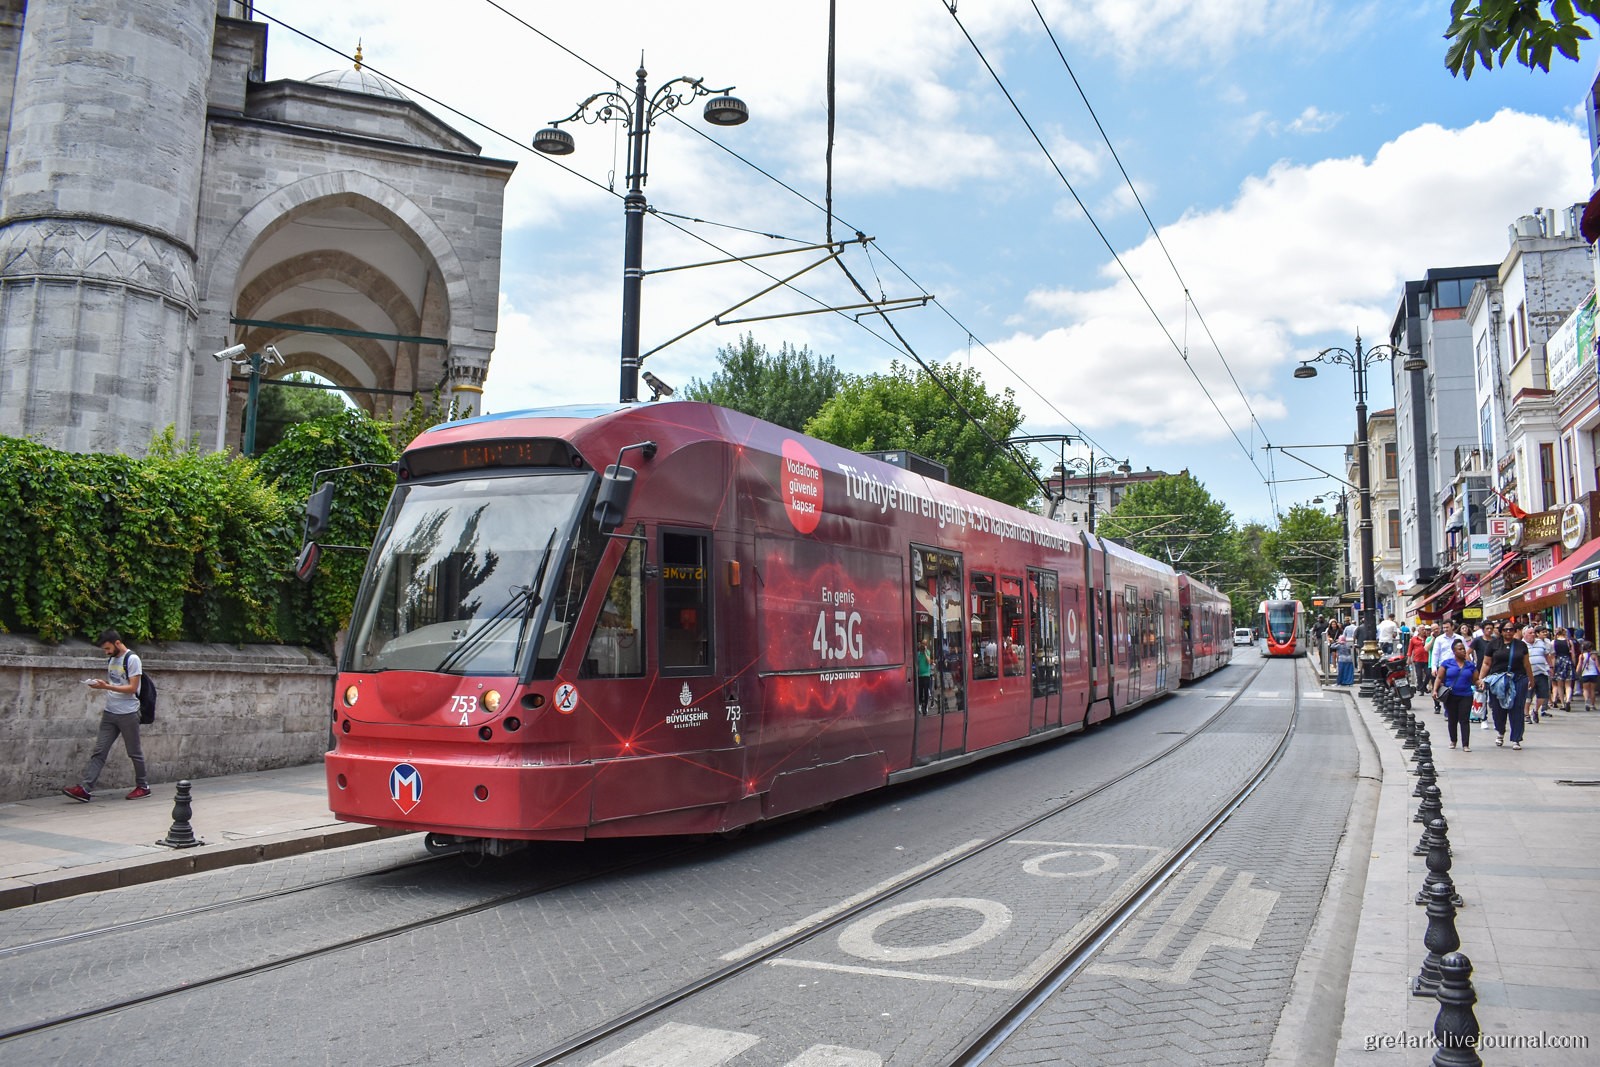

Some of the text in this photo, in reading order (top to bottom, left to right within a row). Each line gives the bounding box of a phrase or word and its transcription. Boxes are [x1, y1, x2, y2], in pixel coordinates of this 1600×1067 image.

[786, 458, 819, 480] Vodafone
[789, 478, 817, 497] güvenle
[791, 496, 816, 515] kapsar
[837, 463, 919, 514] Türkiye'nin
[921, 496, 936, 519] en
[938, 500, 968, 534] geniş
[966, 503, 989, 533] 4.5G
[987, 510, 1032, 543] kapsaması
[1493, 521, 1505, 534] E
[822, 586, 855, 607] En geniş
[812, 610, 863, 660] 4.5G
[450, 695, 478, 713] 753
[725, 705, 741, 721] 753
[459, 712, 469, 726] A
[666, 710, 709, 724] BÜYÜKŞEHİR
[731, 721, 737, 733] A
